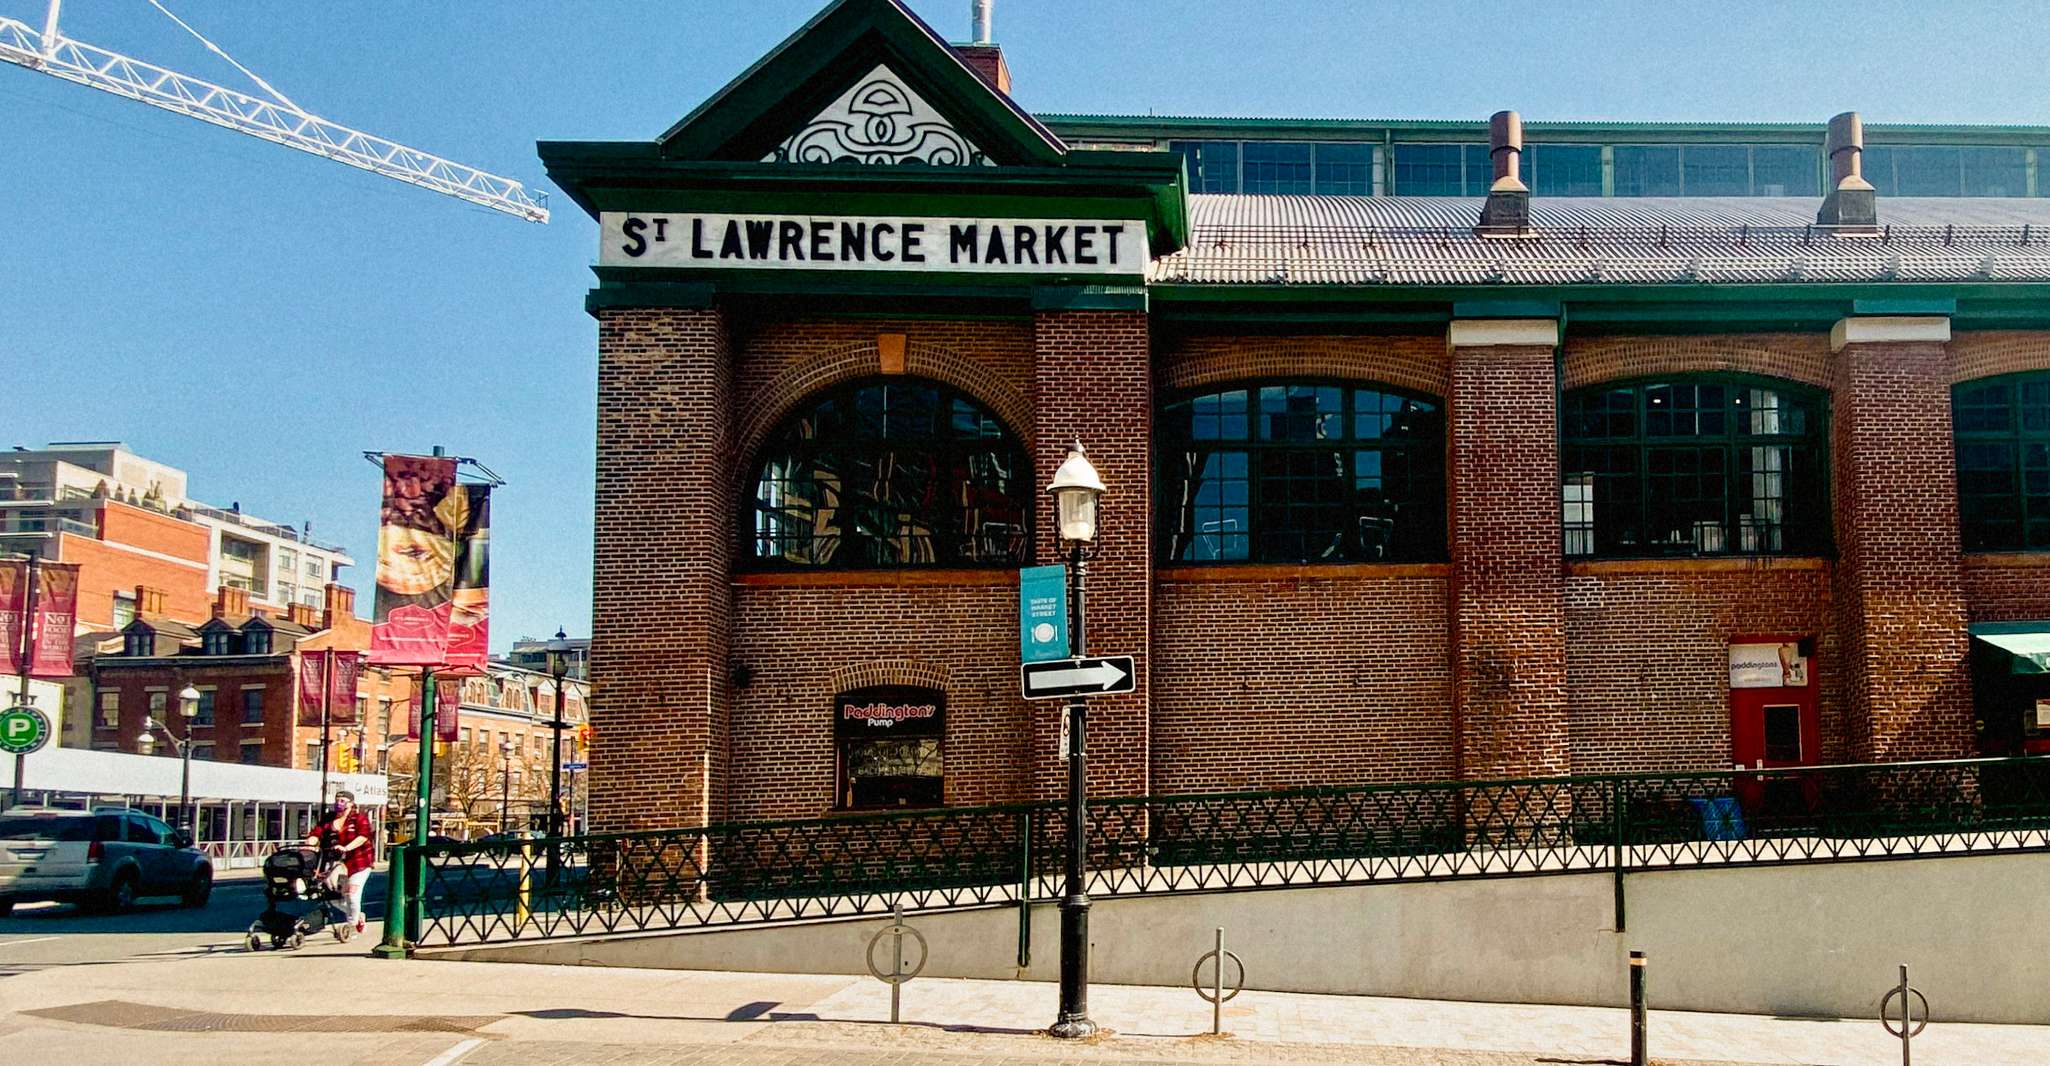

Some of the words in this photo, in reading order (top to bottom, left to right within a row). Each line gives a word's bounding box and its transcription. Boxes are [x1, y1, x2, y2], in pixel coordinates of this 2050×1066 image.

[691, 218, 926, 263] LAWRENCE
[949, 224, 1125, 265] MARKET
[867, 719, 894, 728] Pump
